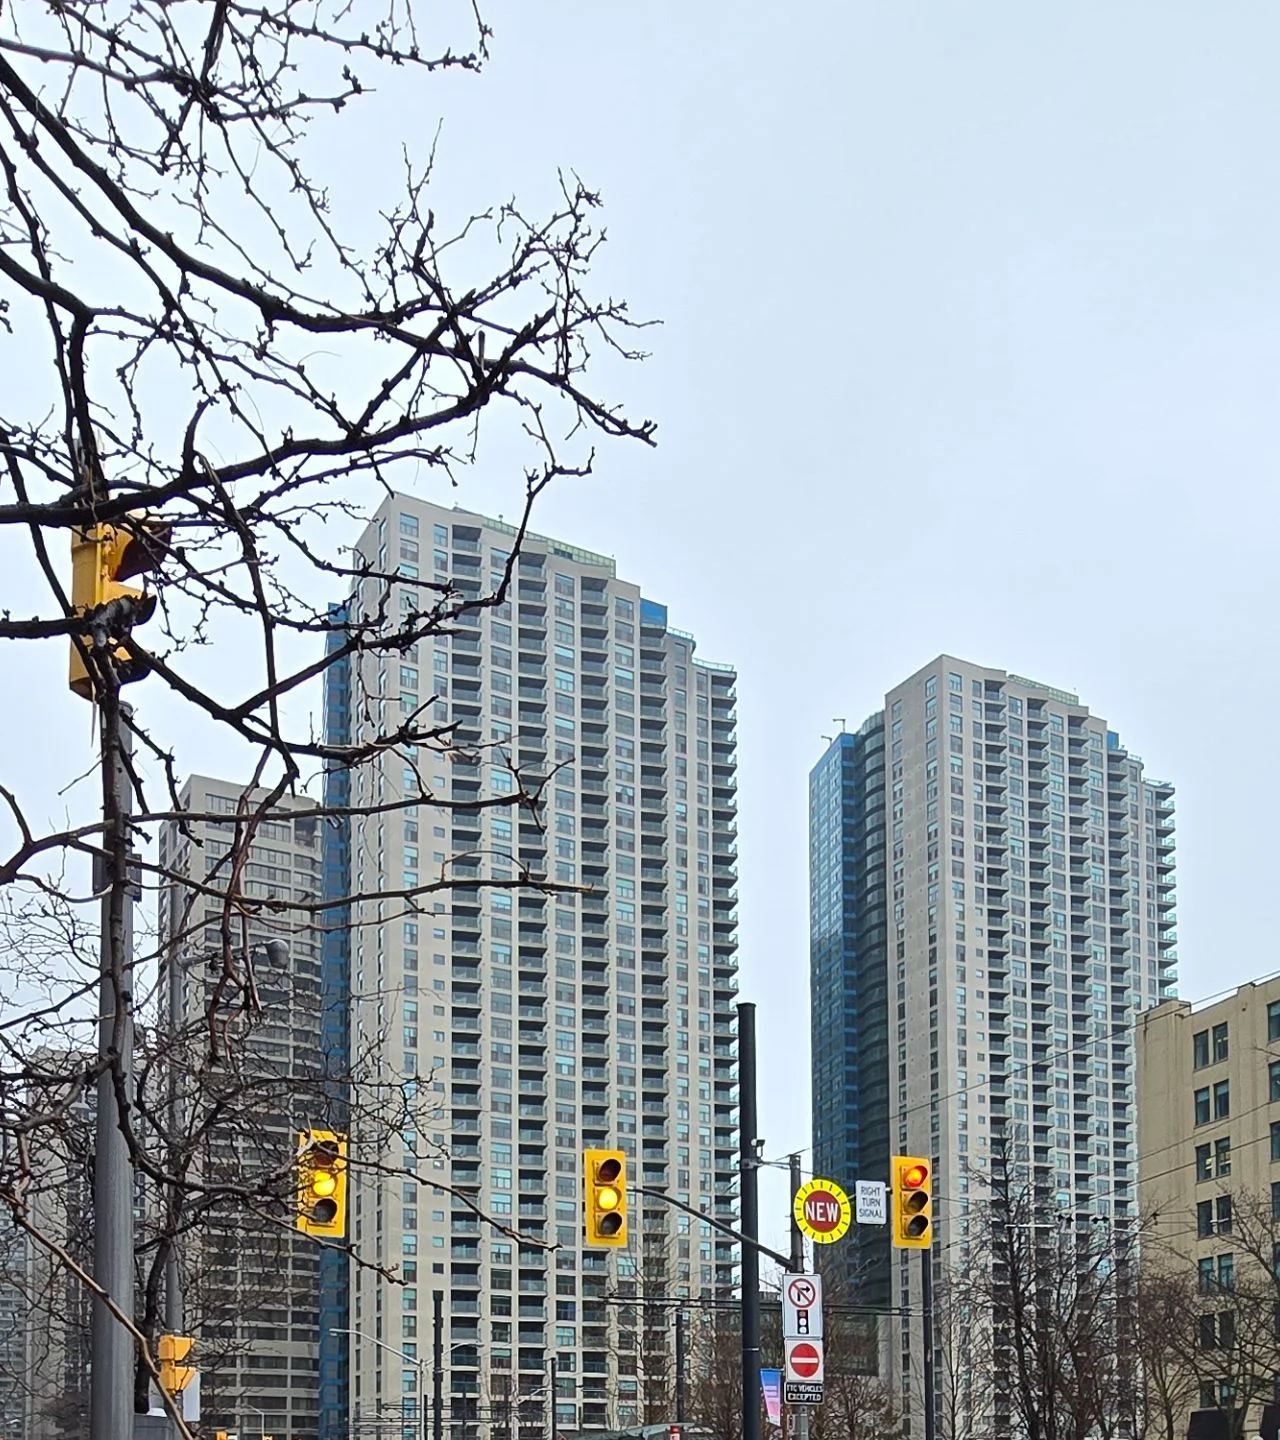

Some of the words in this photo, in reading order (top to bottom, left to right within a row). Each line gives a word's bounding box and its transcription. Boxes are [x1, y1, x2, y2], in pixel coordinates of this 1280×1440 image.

[860, 1186, 881, 1196] RIGHT
[862, 1197, 881, 1207] TURN
[804, 1201, 839, 1223] NEW
[858, 1208, 884, 1218] SIGNAL
